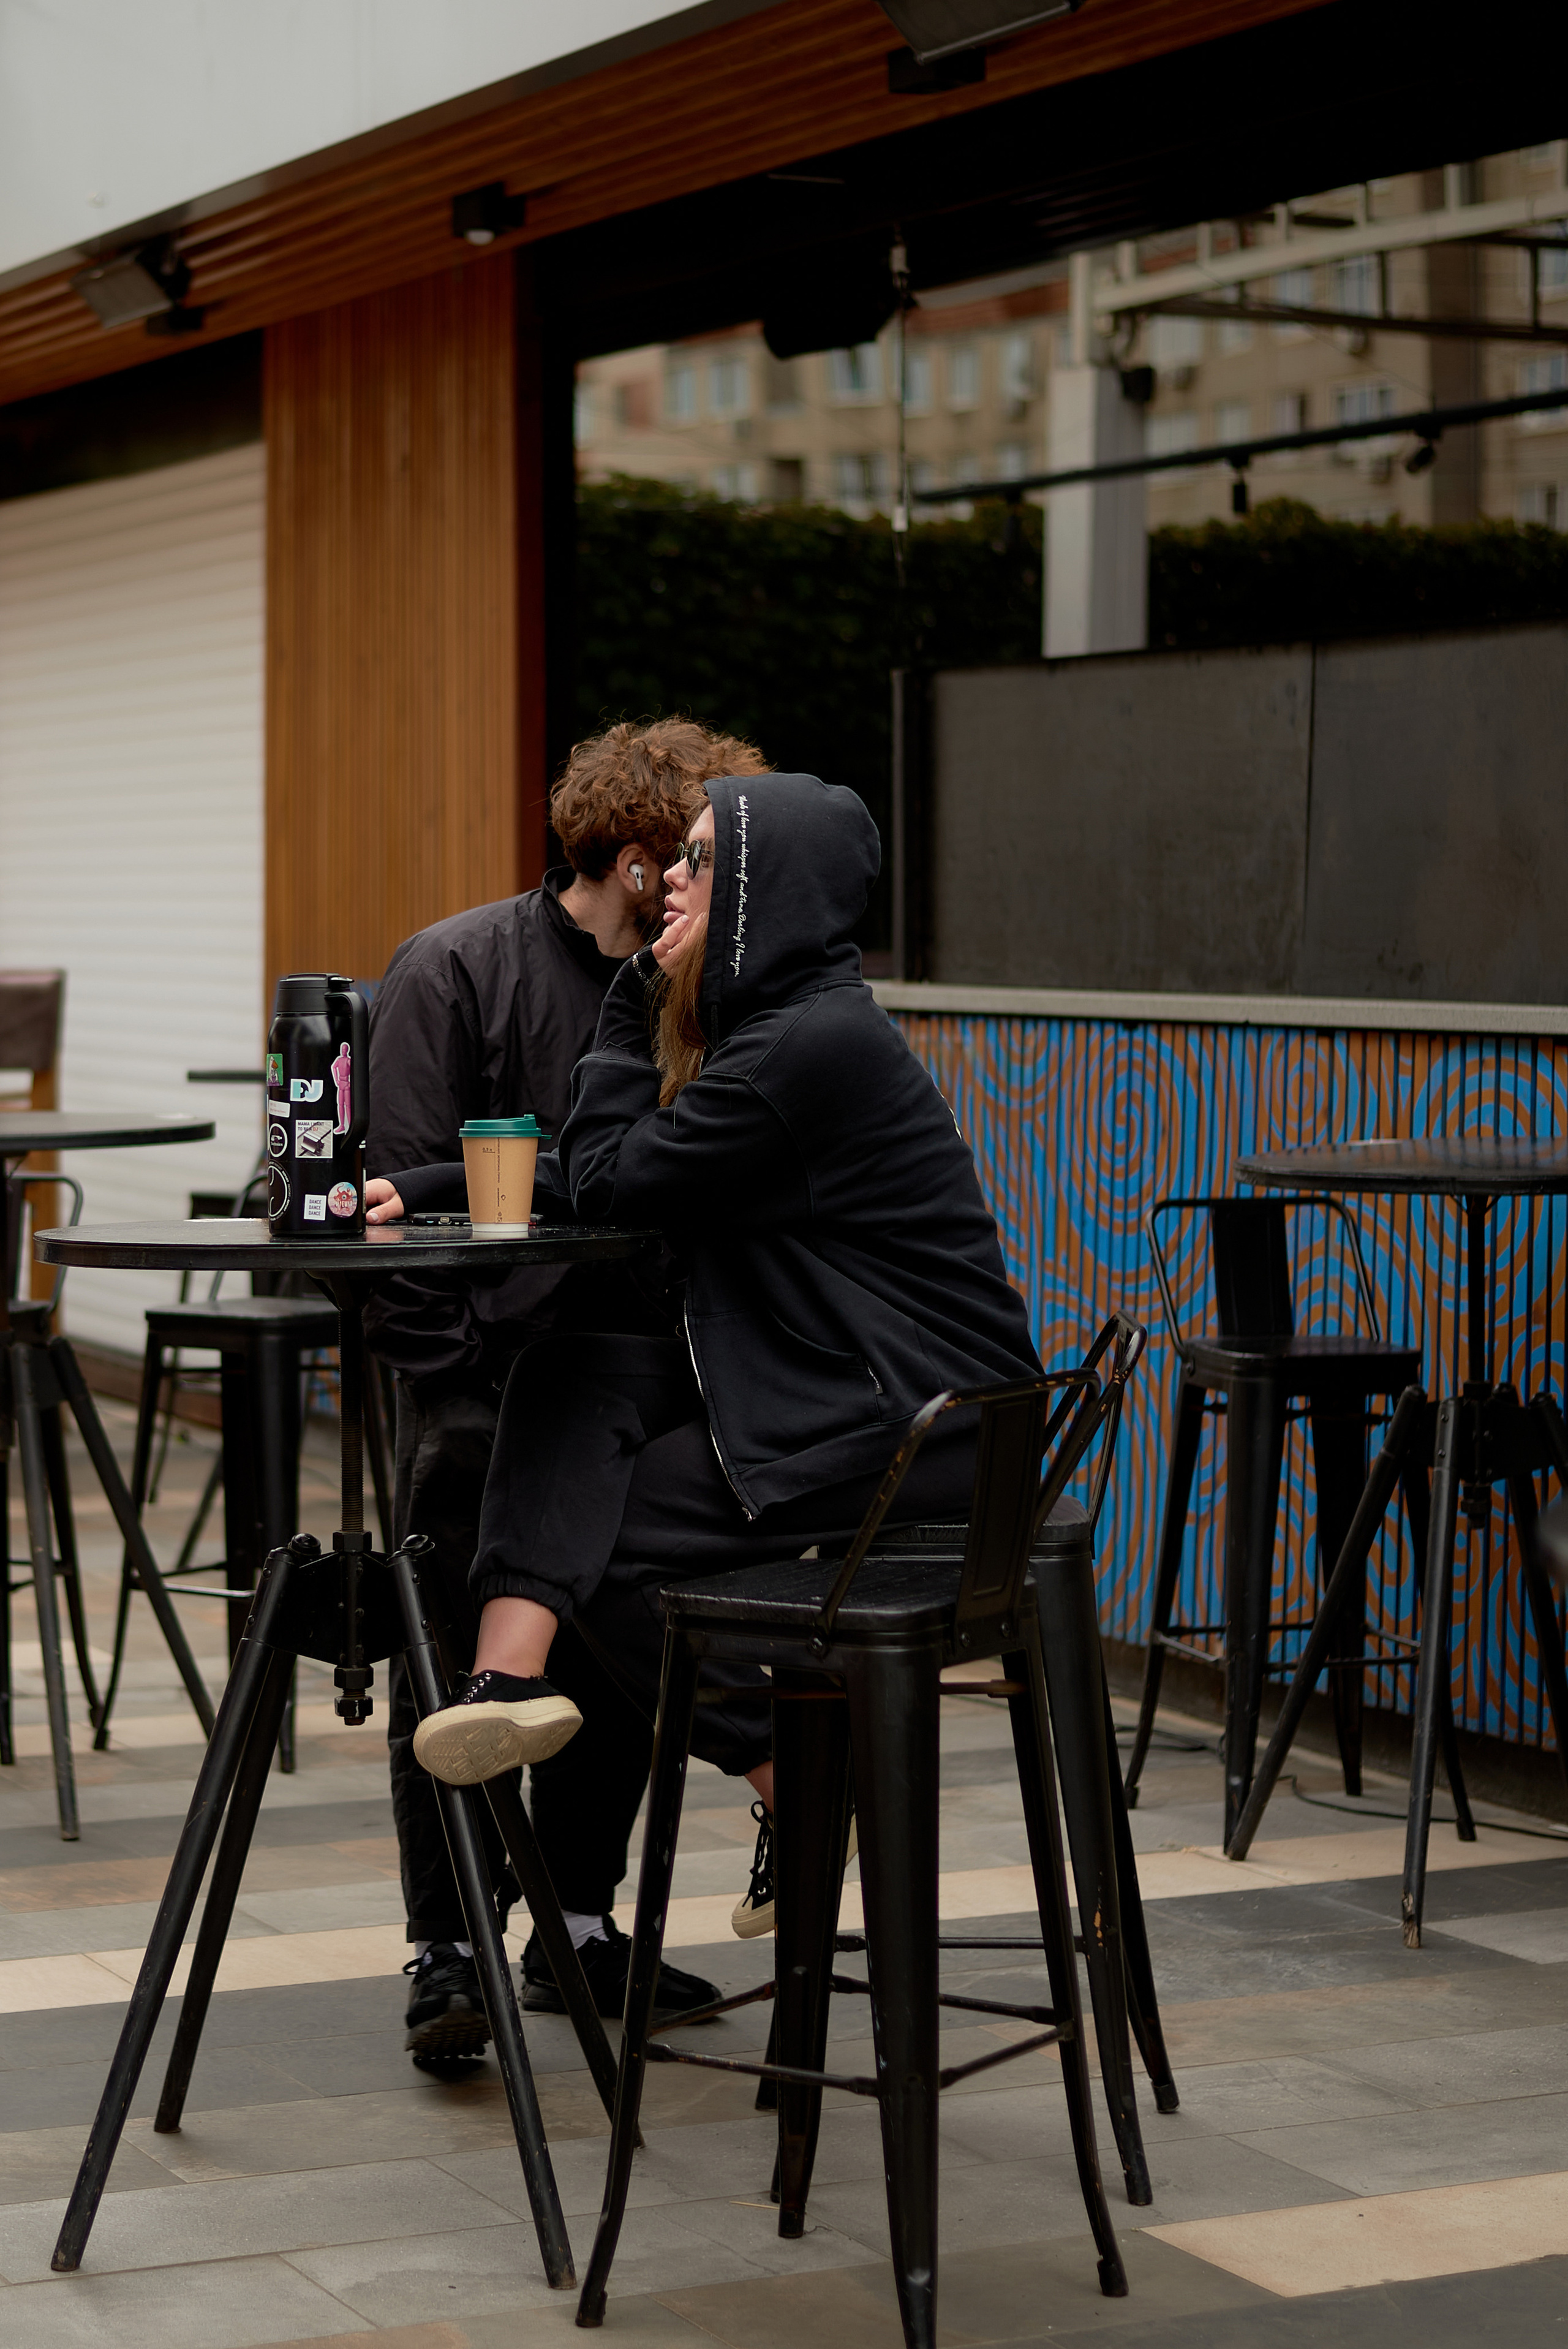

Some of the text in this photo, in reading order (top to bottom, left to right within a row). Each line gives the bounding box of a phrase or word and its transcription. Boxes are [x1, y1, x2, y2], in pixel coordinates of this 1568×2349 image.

[736, 829, 747, 842] you
[737, 844, 750, 868] whisper
[736, 869, 749, 883] soft
[739, 882, 748, 898] and
[733, 914, 747, 941] Darling
[736, 948, 745, 961] love
[291, 1080, 323, 1102] DJ
